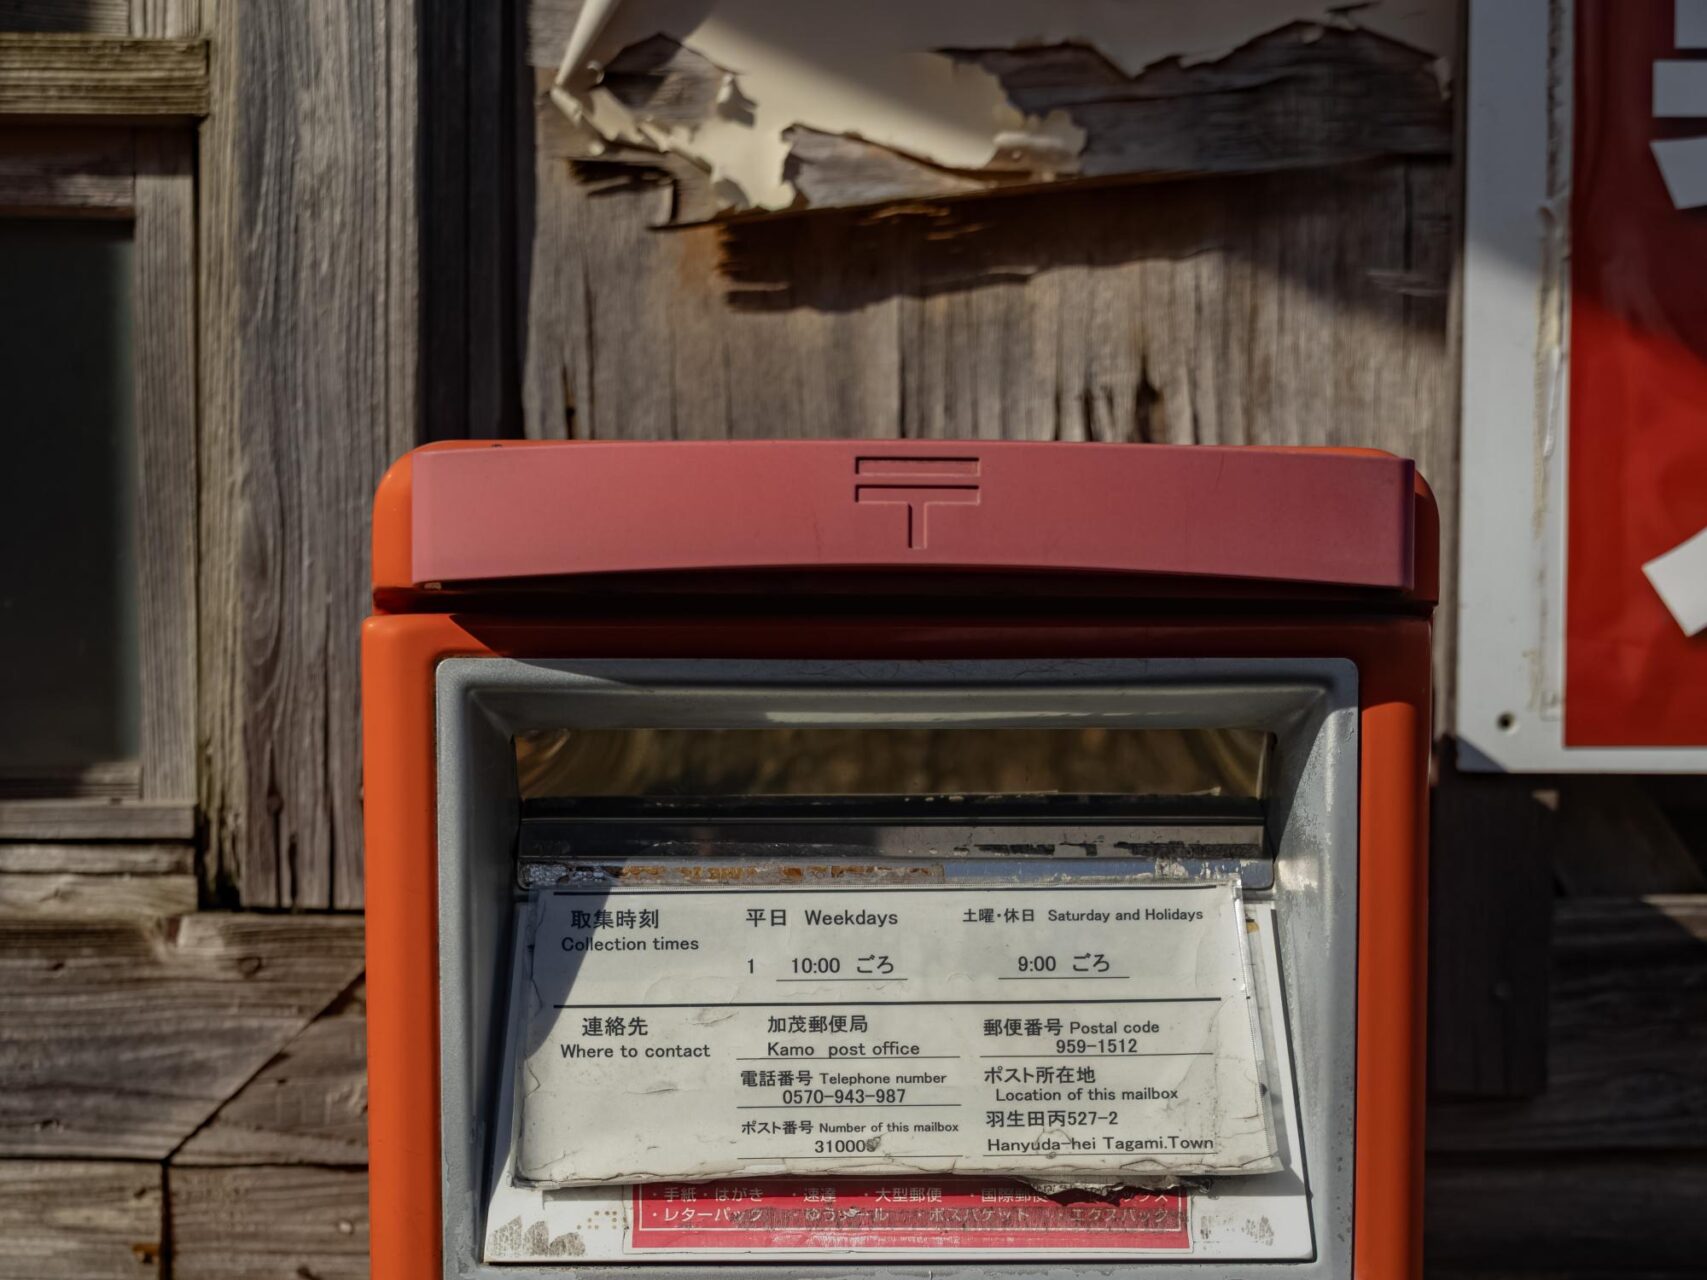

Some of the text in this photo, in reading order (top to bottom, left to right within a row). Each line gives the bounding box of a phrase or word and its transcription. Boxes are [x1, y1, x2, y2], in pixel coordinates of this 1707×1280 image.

[571, 909, 660, 930] 取集時刻
[746, 908, 898, 928] 平日 Weekdays
[963, 907, 1204, 923] 土曜・休日 Saturday and Holidays
[561, 937, 699, 952] Collection times
[747, 954, 894, 974] 1 10:00 ごろ
[1017, 952, 1110, 972] 9:00 ごろ
[582, 1016, 649, 1037] 連絡先
[767, 1015, 868, 1033] 加茂郵便局
[983, 1018, 1160, 1037] 郵便番号 Postal code
[561, 1043, 711, 1058] Where to contact
[767, 1041, 920, 1058] Kamo post office
[1056, 1038, 1138, 1054] 959-1512
[740, 1070, 947, 1087] 電話番号 Telephone number
[984, 1066, 1096, 1084] ポスト所在地
[783, 1089, 906, 1104] 0570-943-987
[996, 1088, 1178, 1101] Location of this mailbox
[741, 1120, 959, 1135] ポスト番号 Number of this mailbox
[986, 1110, 1119, 1128] 羽生田丙527-2
[987, 1137, 1096, 1153] Hanyuda-hei
